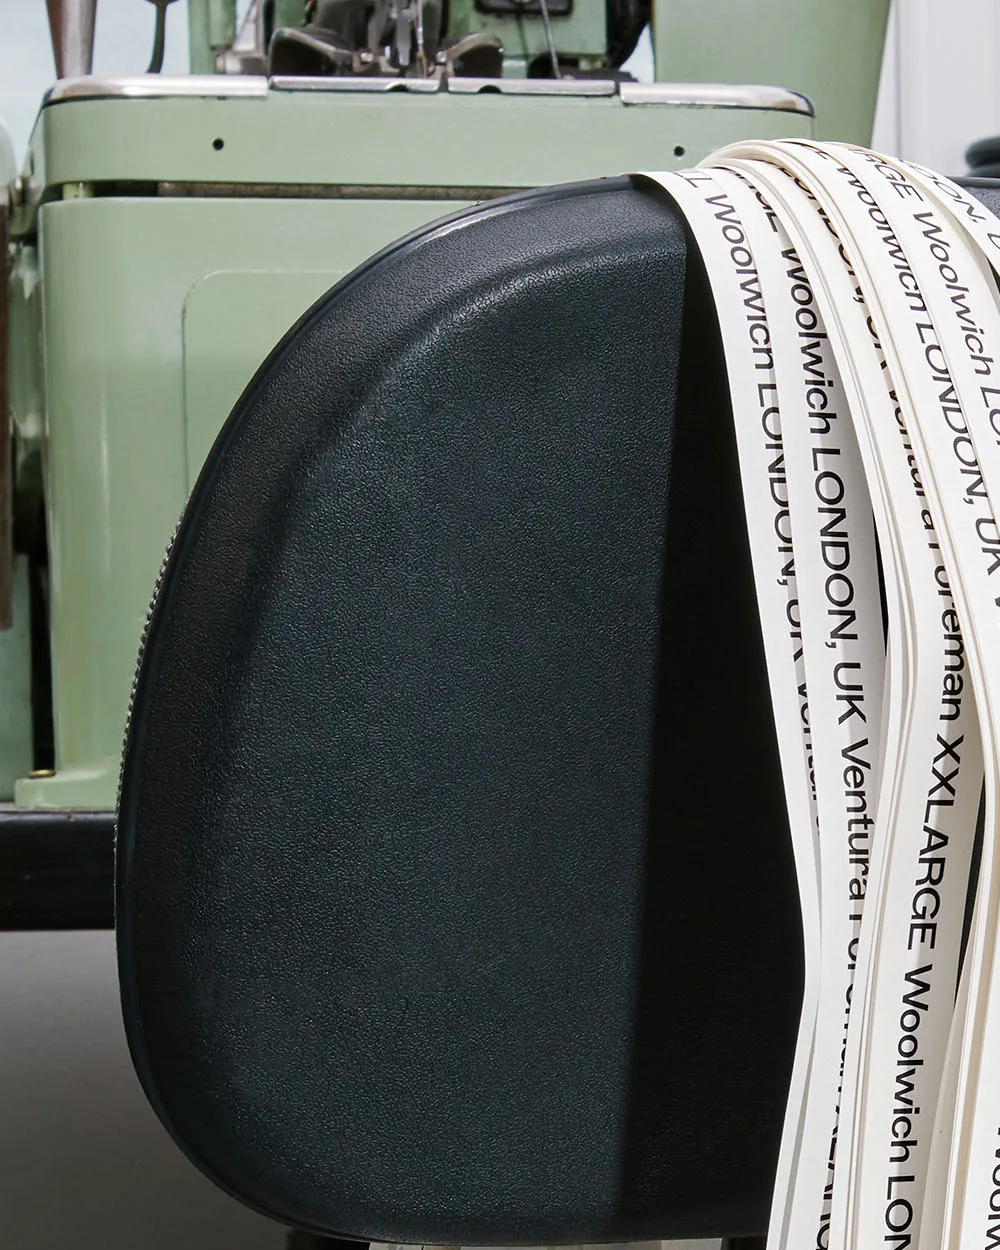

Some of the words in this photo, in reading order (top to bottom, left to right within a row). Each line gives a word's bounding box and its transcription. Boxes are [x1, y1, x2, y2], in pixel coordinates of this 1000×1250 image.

[705, 194, 775, 370] Woolwich
[781, 247, 837, 434] Woolwich
[913, 211, 994, 376] Woolwich
[915, 322, 989, 505] LONDON,
[811, 447, 859, 649] LONDON,
[834, 662, 867, 726] UK
[841, 738, 875, 900] Ventura
[908, 733, 964, 950] XXLARGE
[889, 964, 933, 1163] Woolwich
